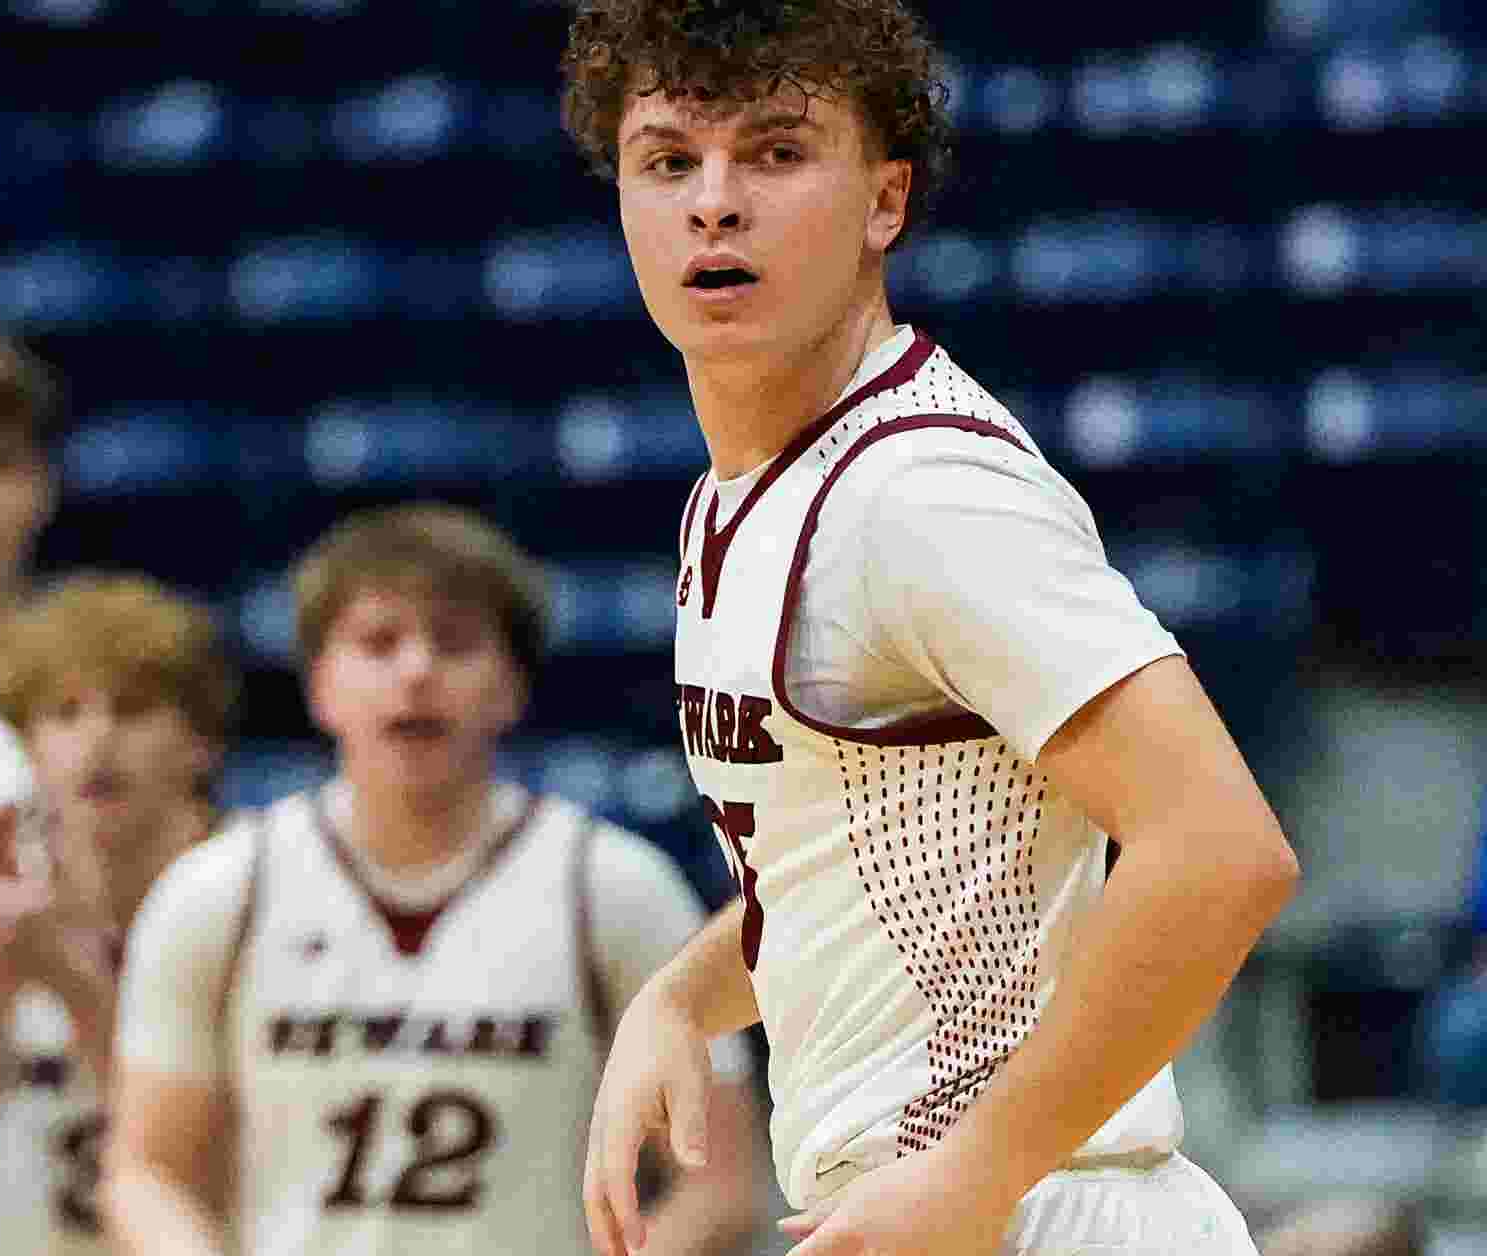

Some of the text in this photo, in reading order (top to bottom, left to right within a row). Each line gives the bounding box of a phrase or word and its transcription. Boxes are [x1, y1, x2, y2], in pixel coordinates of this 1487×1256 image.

[676, 683, 784, 765] WARK
[264, 1008, 560, 1060] NEWARK
[322, 1086, 498, 1212] 12
